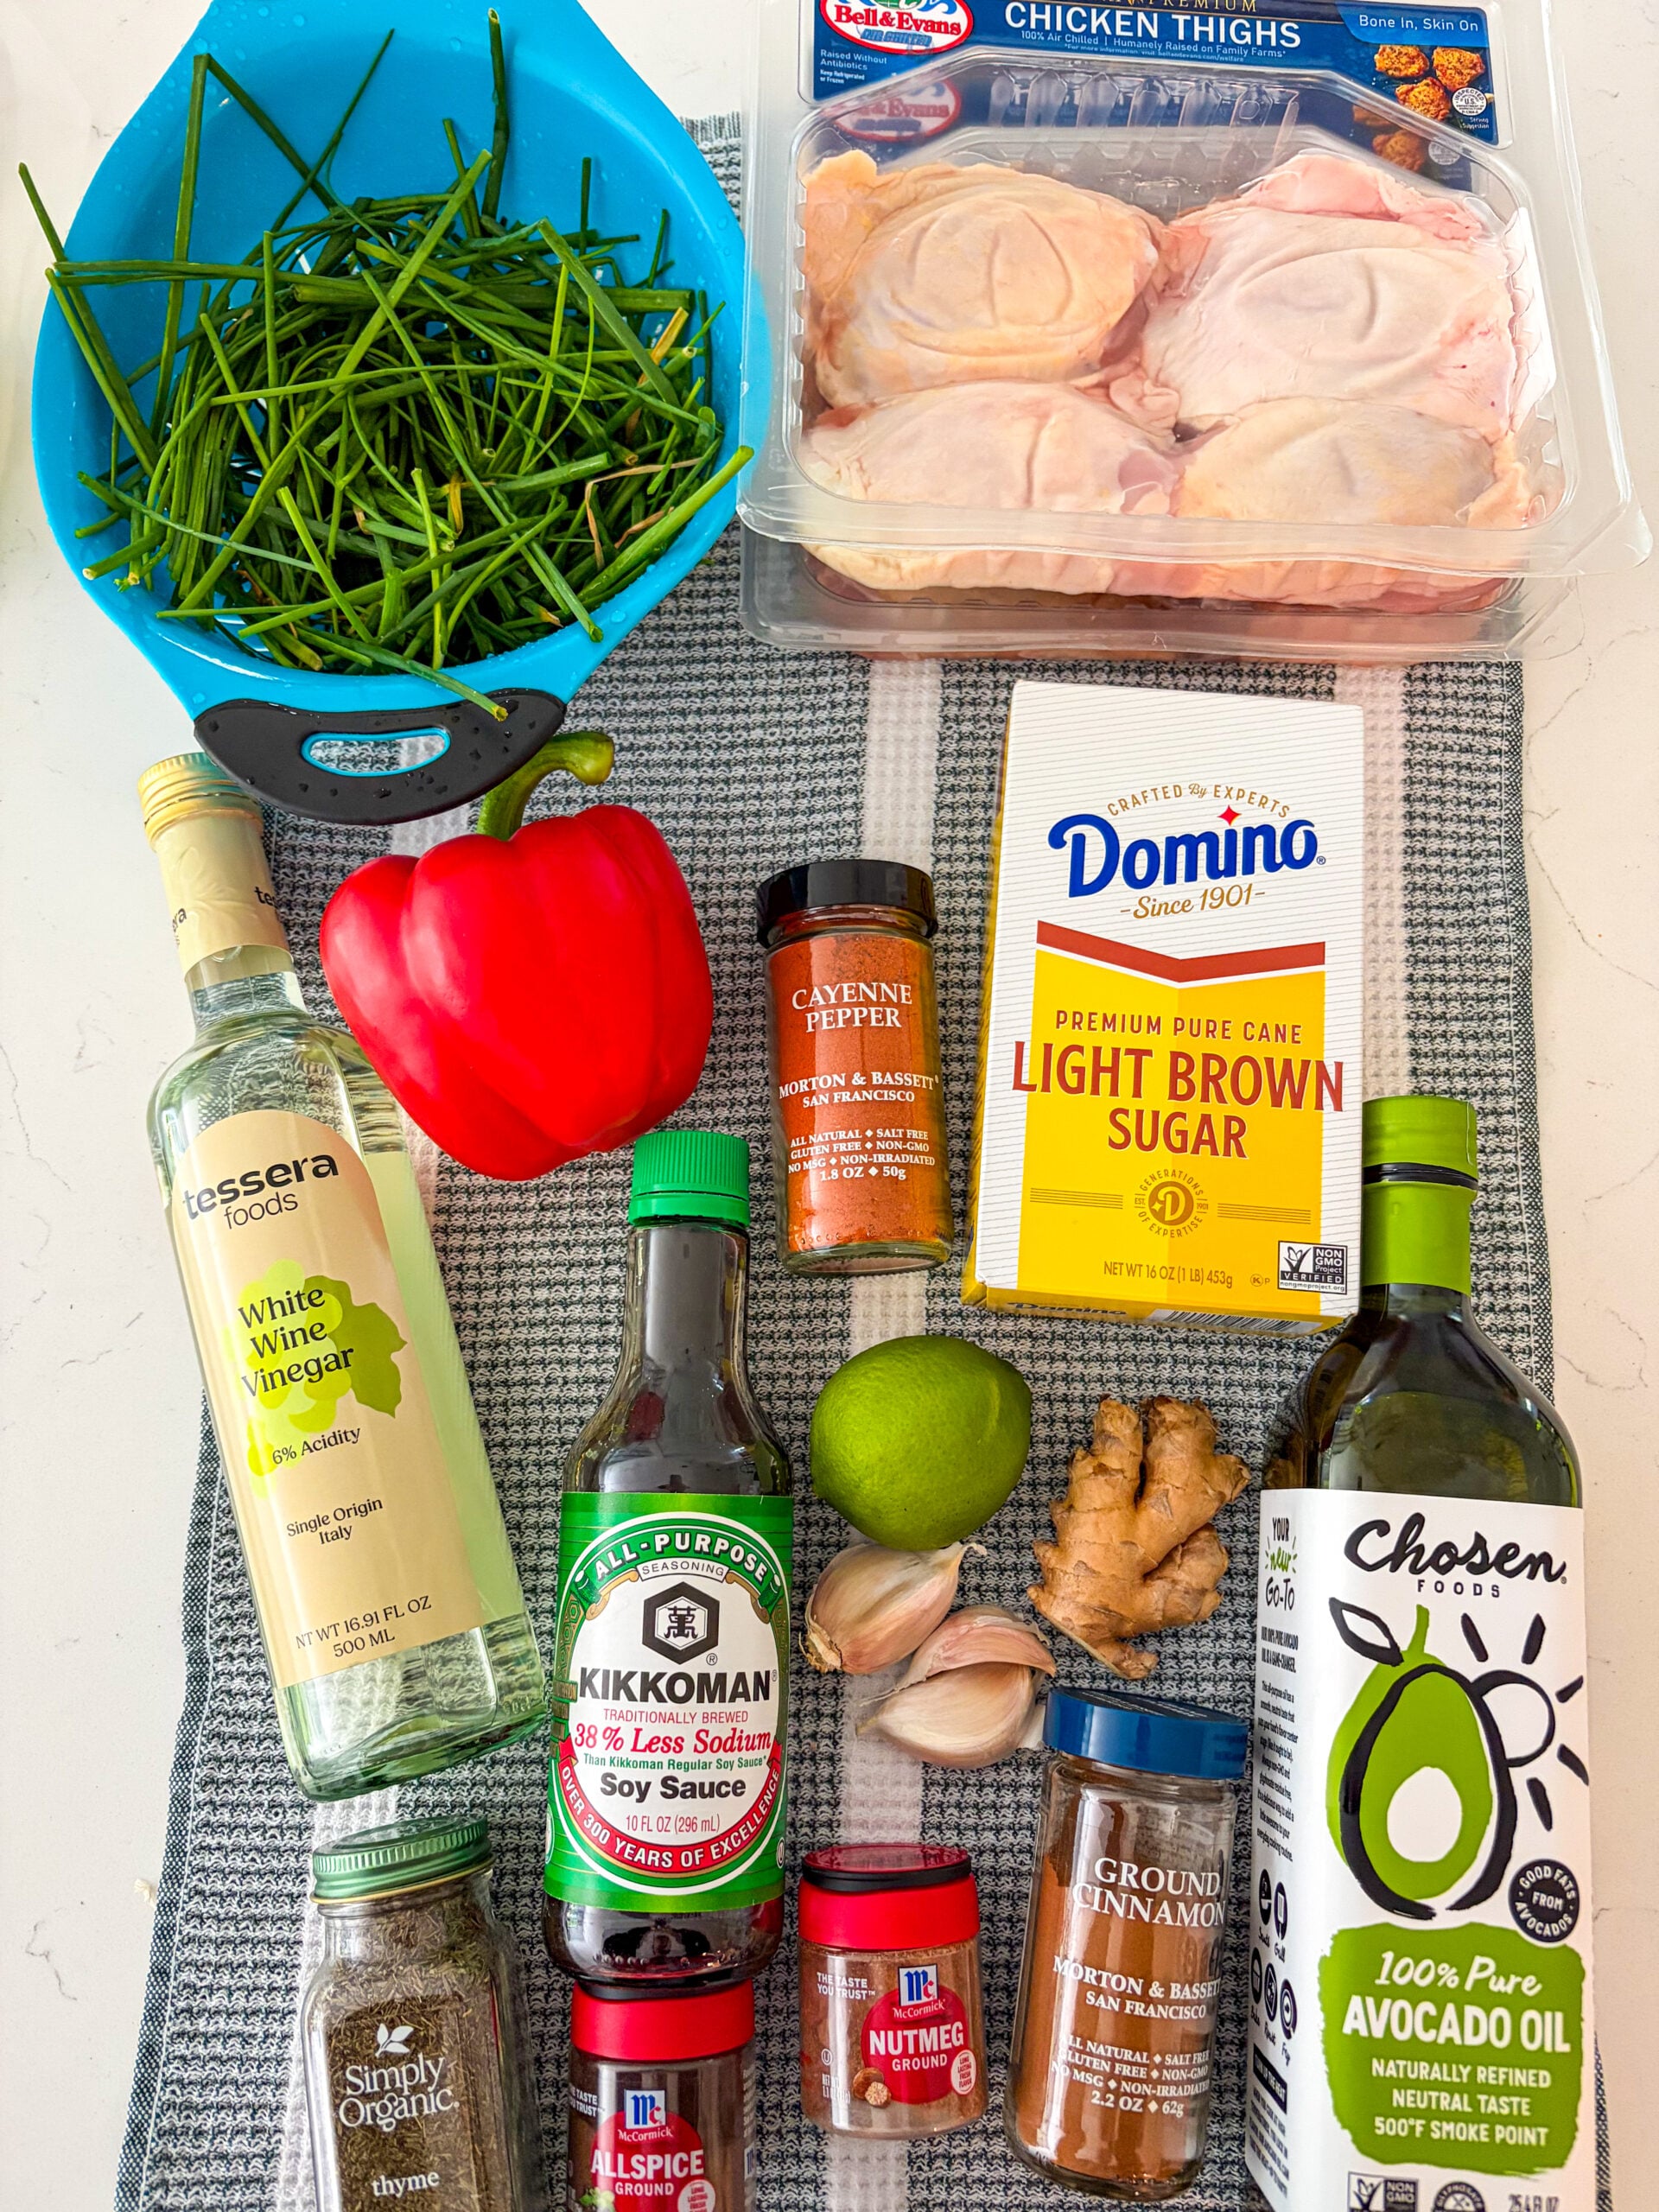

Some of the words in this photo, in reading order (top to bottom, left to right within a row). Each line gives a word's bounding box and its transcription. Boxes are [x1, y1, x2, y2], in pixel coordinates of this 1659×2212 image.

[1005, 2, 1159, 38] CHICKEN
[1172, 15, 1301, 48] THIGHS
[1359, 15, 1395, 28] Bone
[1401, 17, 1418, 30] In,
[1423, 18, 1454, 31] Skin
[1459, 21, 1478, 31] On
[820, 49, 851, 60] Raised
[854, 54, 887, 65] Without
[1021, 30, 1045, 41] 100%
[1047, 33, 1062, 41] Air
[1065, 34, 1098, 45] Chilled
[1114, 38, 1162, 50] Humanely
[1166, 41, 1198, 52] Raised
[1216, 45, 1249, 57] Family
[820, 59, 868, 70] Antibiotics
[1107, 784, 1183, 817] CRAFTED
[1188, 782, 1207, 798] By
[1213, 785, 1290, 818] EXPERTS
[1048, 813, 1319, 899] Domino
[791, 982, 913, 1010] CAYENNE
[805, 1007, 902, 1033] PEPPER
[1055, 1010, 1162, 1035] PREMIUM
[1173, 1017, 1232, 1039] PURE
[1243, 1021, 1302, 1045] CANE
[779, 1072, 846, 1100] MORTON
[851, 1071, 867, 1086] &
[871, 1071, 934, 1090] BASSETT
[1012, 1040, 1154, 1099] LIGHT
[1167, 1050, 1344, 1112] BROWN
[803, 1091, 830, 1108] SAN
[834, 1090, 915, 1103] FRANCISCO
[791, 1135, 806, 1148] ALL
[809, 1128, 862, 1144] NATURAL
[876, 1128, 905, 1139] SALT
[906, 1129, 929, 1140] FREE
[1108, 1107, 1248, 1159] SUGAR
[788, 1161, 801, 1174] NO
[803, 1157, 826, 1169] MSG
[841, 1154, 935, 1166] NON-IRRADIATED
[791, 1144, 830, 1160] GLUTEN
[833, 1141, 861, 1154] FREE
[876, 1141, 929, 1152] NON-GMO
[182, 1154, 340, 1219] tessera
[819, 1168, 838, 1181] 1.8
[842, 1166, 864, 1179] OZ
[882, 1166, 906, 1180] 50g
[1140, 1168, 1204, 1196] GENERATIONS
[224, 1191, 299, 1230] foods
[1138, 1211, 1150, 1223] OF
[1149, 1215, 1203, 1238] EXPERTISE
[1315, 1257, 1343, 1267] GMO
[1316, 1249, 1342, 1259] NON
[1103, 1261, 1123, 1276] NET
[1125, 1262, 1143, 1277] WT
[1145, 1264, 1157, 1279] 16
[1159, 1265, 1175, 1281] OZ
[1190, 1267, 1205, 1285] LB)
[1207, 1269, 1233, 1288] 453g
[1284, 1272, 1342, 1283] VERIFIED
[1315, 1265, 1342, 1274] Project
[238, 1288, 326, 1329] White
[250, 1321, 327, 1359] Wine
[241, 1348, 355, 1397] Vinegar
[272, 1445, 297, 1465] 6%
[301, 1427, 361, 1456] Acidity
[286, 1513, 331, 1537] Single
[334, 1498, 383, 1522] Origin
[1272, 1516, 1289, 1541] YOUR
[319, 1525, 353, 1545] Italy
[1344, 1512, 1567, 1583] Chosen
[594, 1532, 768, 1584] ALL-PURPOSE
[641, 1560, 724, 1577] SEASONING
[1417, 1580, 1500, 1599] FOODS
[296, 1631, 314, 1649] NT
[315, 1623, 341, 1642] WT
[344, 1611, 381, 1634] 16.91
[383, 1605, 404, 1622] FL
[407, 1595, 432, 1614] OZ
[334, 1635, 366, 1657] 500
[369, 1629, 396, 1647] ML
[579, 1666, 771, 1704] KIKKOMAN
[603, 1708, 696, 1725] TRADITIONALLY
[702, 1710, 748, 1725] BREWED
[631, 1727, 684, 1753] Less
[693, 1727, 771, 1754] Sodium
[583, 1752, 606, 1766] Than
[609, 1754, 664, 1770] Kikkoman
[667, 1757, 713, 1772] Regular
[715, 1757, 734, 1770] Soy
[600, 1771, 652, 1803] Soy
[659, 1775, 747, 1800] Sauce
[562, 1765, 585, 1816] OVER
[583, 1813, 611, 1846] 300
[614, 1840, 673, 1868] YEARS
[680, 1849, 705, 1867] OF
[710, 1767, 779, 1859] EXCELLENCE
[626, 1816, 638, 1832] 10
[641, 1815, 652, 1833] FL
[656, 1816, 671, 1833] OZ
[674, 1815, 697, 1835] (296
[701, 1814, 721, 1833] mL)
[1094, 1858, 1220, 1897] GROUND
[1519, 1866, 1552, 1890] GOOD
[1554, 1868, 1576, 1900] FATS
[1072, 1882, 1226, 1928] CINNAMON
[1532, 1891, 1563, 1911] FROM
[1515, 1902, 1573, 1937] AVOCADOS
[817, 1972, 833, 1985] THE
[836, 1975, 868, 1988] TASTE
[1052, 1955, 1144, 1996] MORTON
[1148, 1980, 1165, 1999] &
[1375, 1951, 1460, 1988] 100%
[1465, 1955, 1542, 1997] Pure
[817, 1984, 834, 1995] YOU
[893, 1999, 946, 2019] McCormick
[1086, 1991, 1120, 2012] SAN
[1124, 1999, 1206, 2020] FRANCISCO
[1342, 1994, 1511, 2049] AVOCADO
[1520, 2009, 1572, 2053] OIL
[869, 2021, 964, 2056] NUTMEG
[892, 2053, 947, 2071] GROUND
[1086, 2040, 1150, 2064] NATURAL
[1165, 2053, 1191, 2065] SALT
[346, 2053, 445, 2096] Simply
[1072, 2068, 1104, 2088] MSG
[1115, 2063, 1147, 2079] FREE
[1162, 2065, 1208, 2081] NON-GMO
[1371, 2058, 1471, 2083] NATURALLY
[1477, 2066, 1551, 2088] REFINED
[576, 2088, 598, 2106] TASTE
[1091, 2090, 1115, 2108] 2.2
[1119, 2096, 1144, 2113] OZ
[1161, 2101, 1185, 2119] 62g
[1392, 2089, 1472, 2113] NEUTRAL
[1477, 2094, 1531, 2116] TASTE
[618, 2127, 674, 2143] McCormick
[1430, 2120, 1489, 2142] SMOKE
[1495, 2125, 1548, 2146] POINT
[590, 2149, 704, 2180] ALLSPICE
[372, 2171, 442, 2198] thyme
[615, 2182, 674, 2196] GROUND
[1386, 2192, 1415, 2202] GMO
[1387, 2182, 1414, 2193] NON
